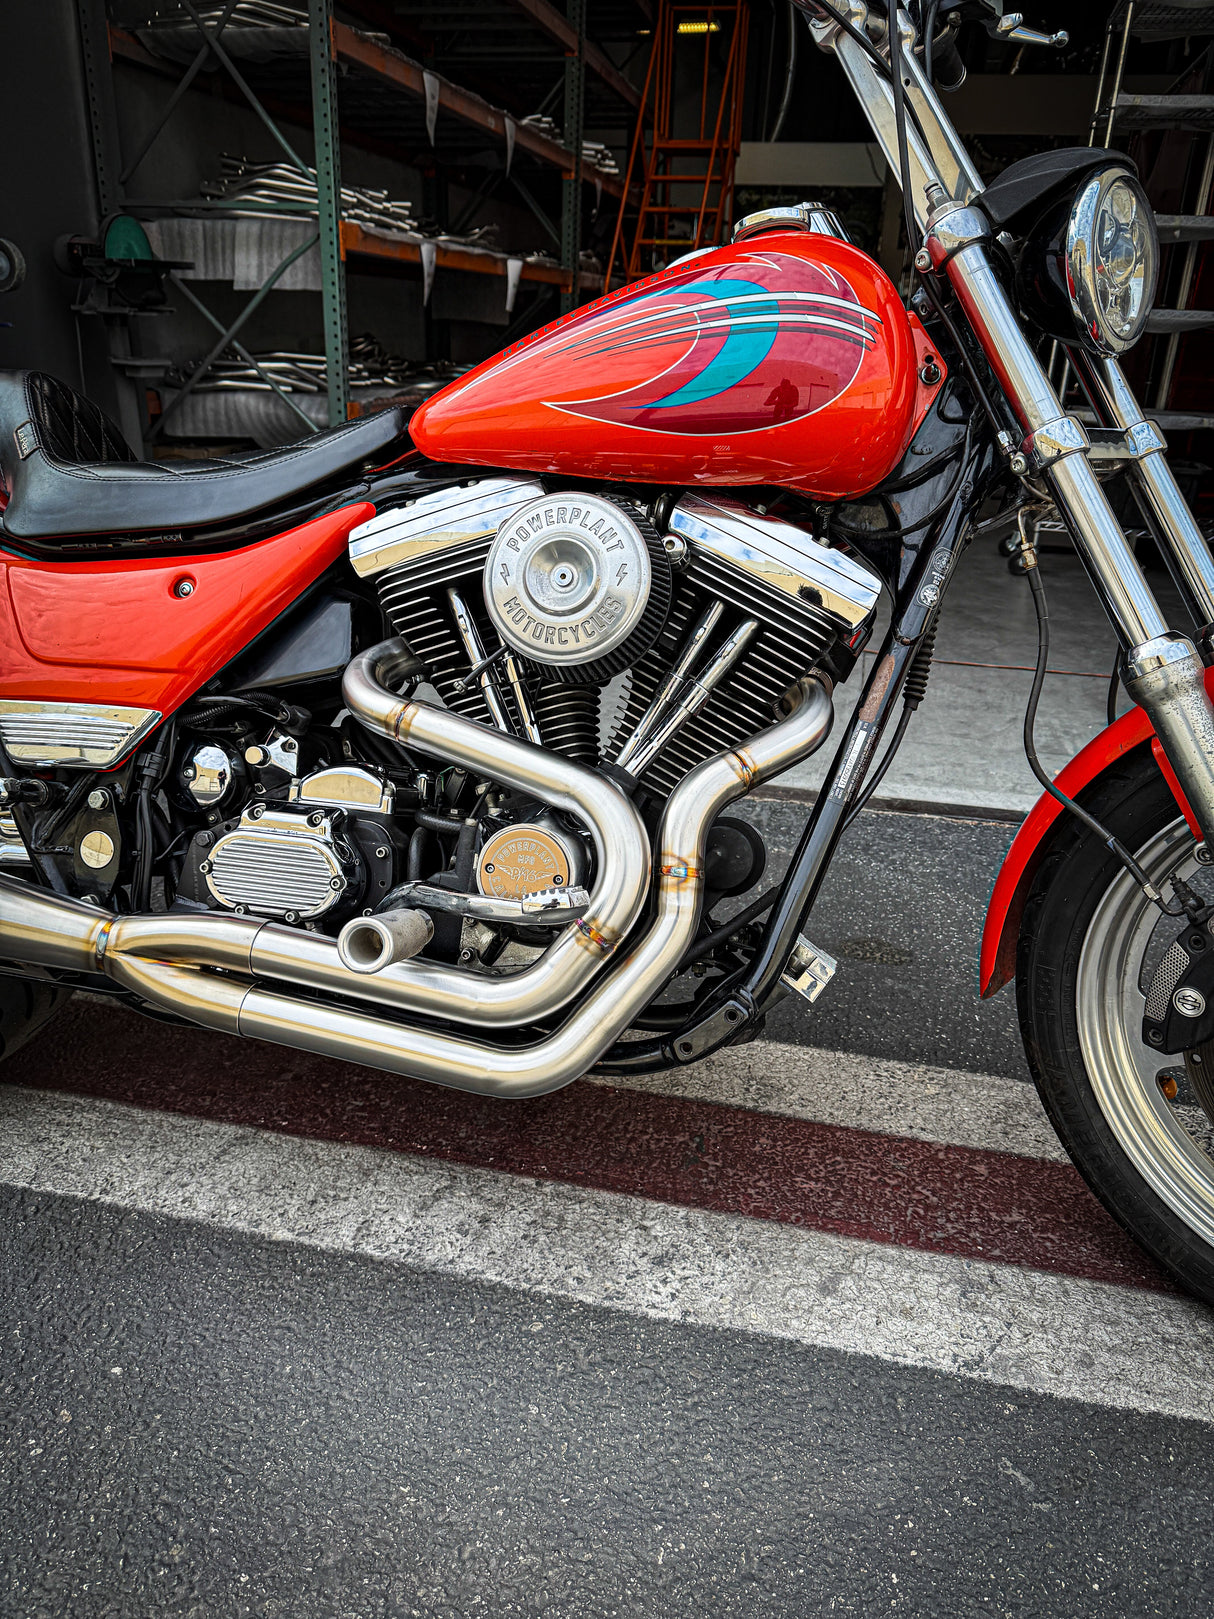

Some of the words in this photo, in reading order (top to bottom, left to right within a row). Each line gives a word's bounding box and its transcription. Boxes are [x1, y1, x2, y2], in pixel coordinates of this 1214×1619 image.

[502, 263, 692, 358] HARLEY-DAVIDSON
[506, 506, 625, 553] POWERPLANT
[503, 595, 623, 646] MOTORCYCLES
[497, 842, 555, 870] POWERPLANT
